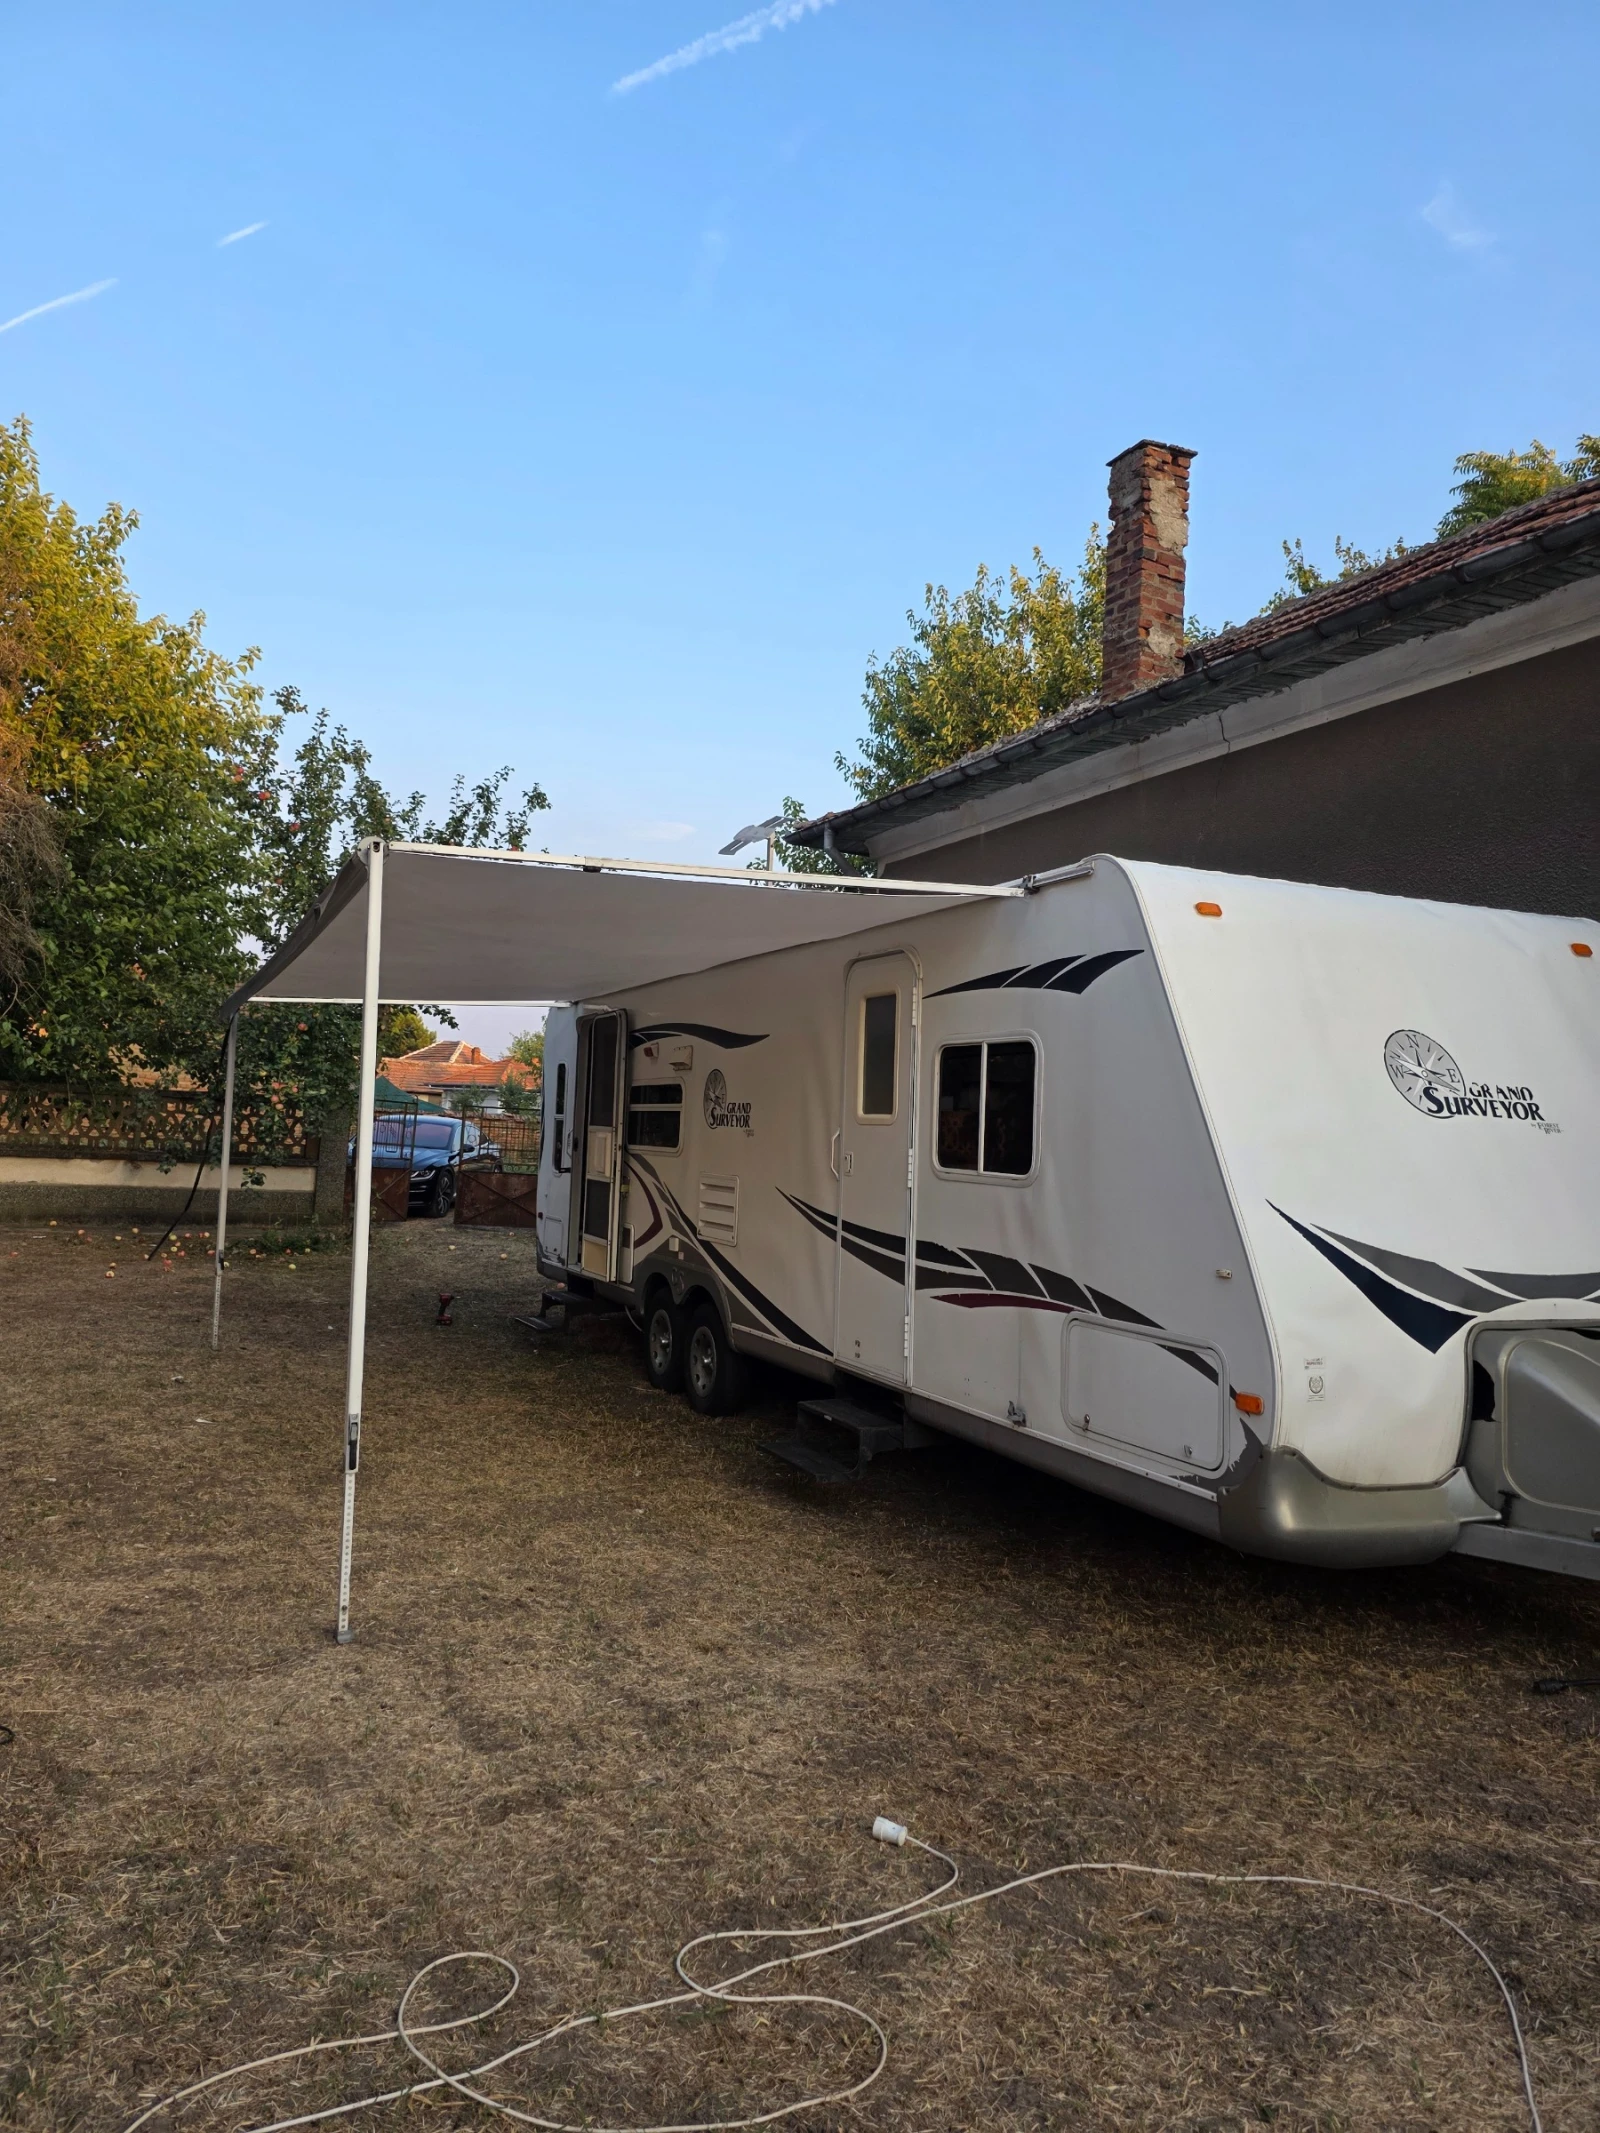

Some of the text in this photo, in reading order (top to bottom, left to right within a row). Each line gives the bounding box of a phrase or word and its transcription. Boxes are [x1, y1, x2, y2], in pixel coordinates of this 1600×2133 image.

[1405, 1034, 1420, 1048] N
[1445, 1068, 1460, 1083] E
[1469, 1082, 1534, 1101] GRAND
[726, 1102, 752, 1115] GRAND
[1422, 1086, 1546, 1121] SURVEYOR
[709, 1106, 752, 1128] SURVEYOR
